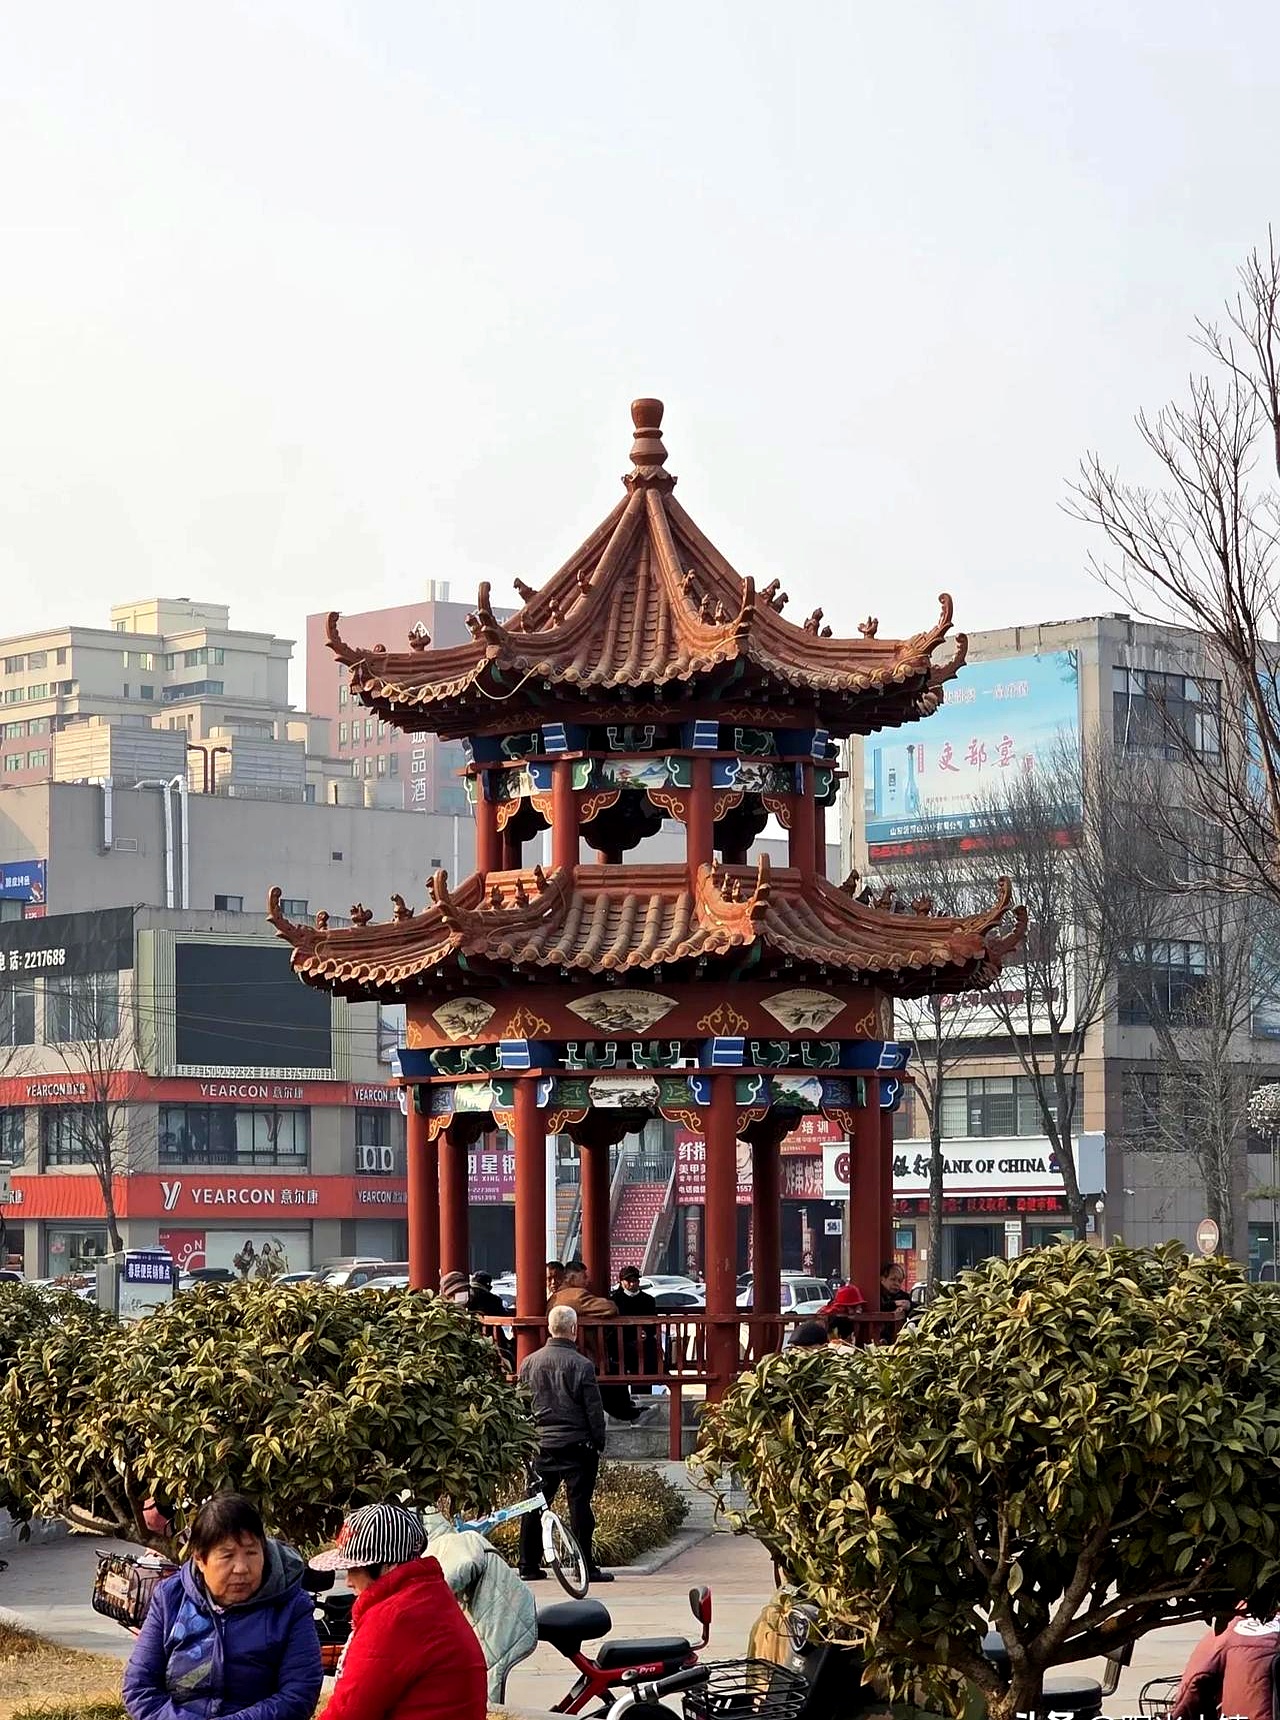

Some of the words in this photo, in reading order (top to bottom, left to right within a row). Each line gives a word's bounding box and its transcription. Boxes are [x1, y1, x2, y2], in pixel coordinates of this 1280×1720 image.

[26, 1082, 65, 1097] YEARCON
[200, 1083, 268, 1098] YEARCON
[354, 1086, 388, 1102] YEARCON
[943, 1159, 975, 1174] ANK
[976, 1159, 994, 1174] OF
[998, 1157, 1046, 1174] CHINA
[192, 1188, 276, 1205] YEARCON
[280, 1188, 319, 1205] 意尔康
[358, 1190, 392, 1204] YEARCON
[128, 1263, 171, 1280] 春联便民销售点
[640, 1666, 656, 1674] Pro
